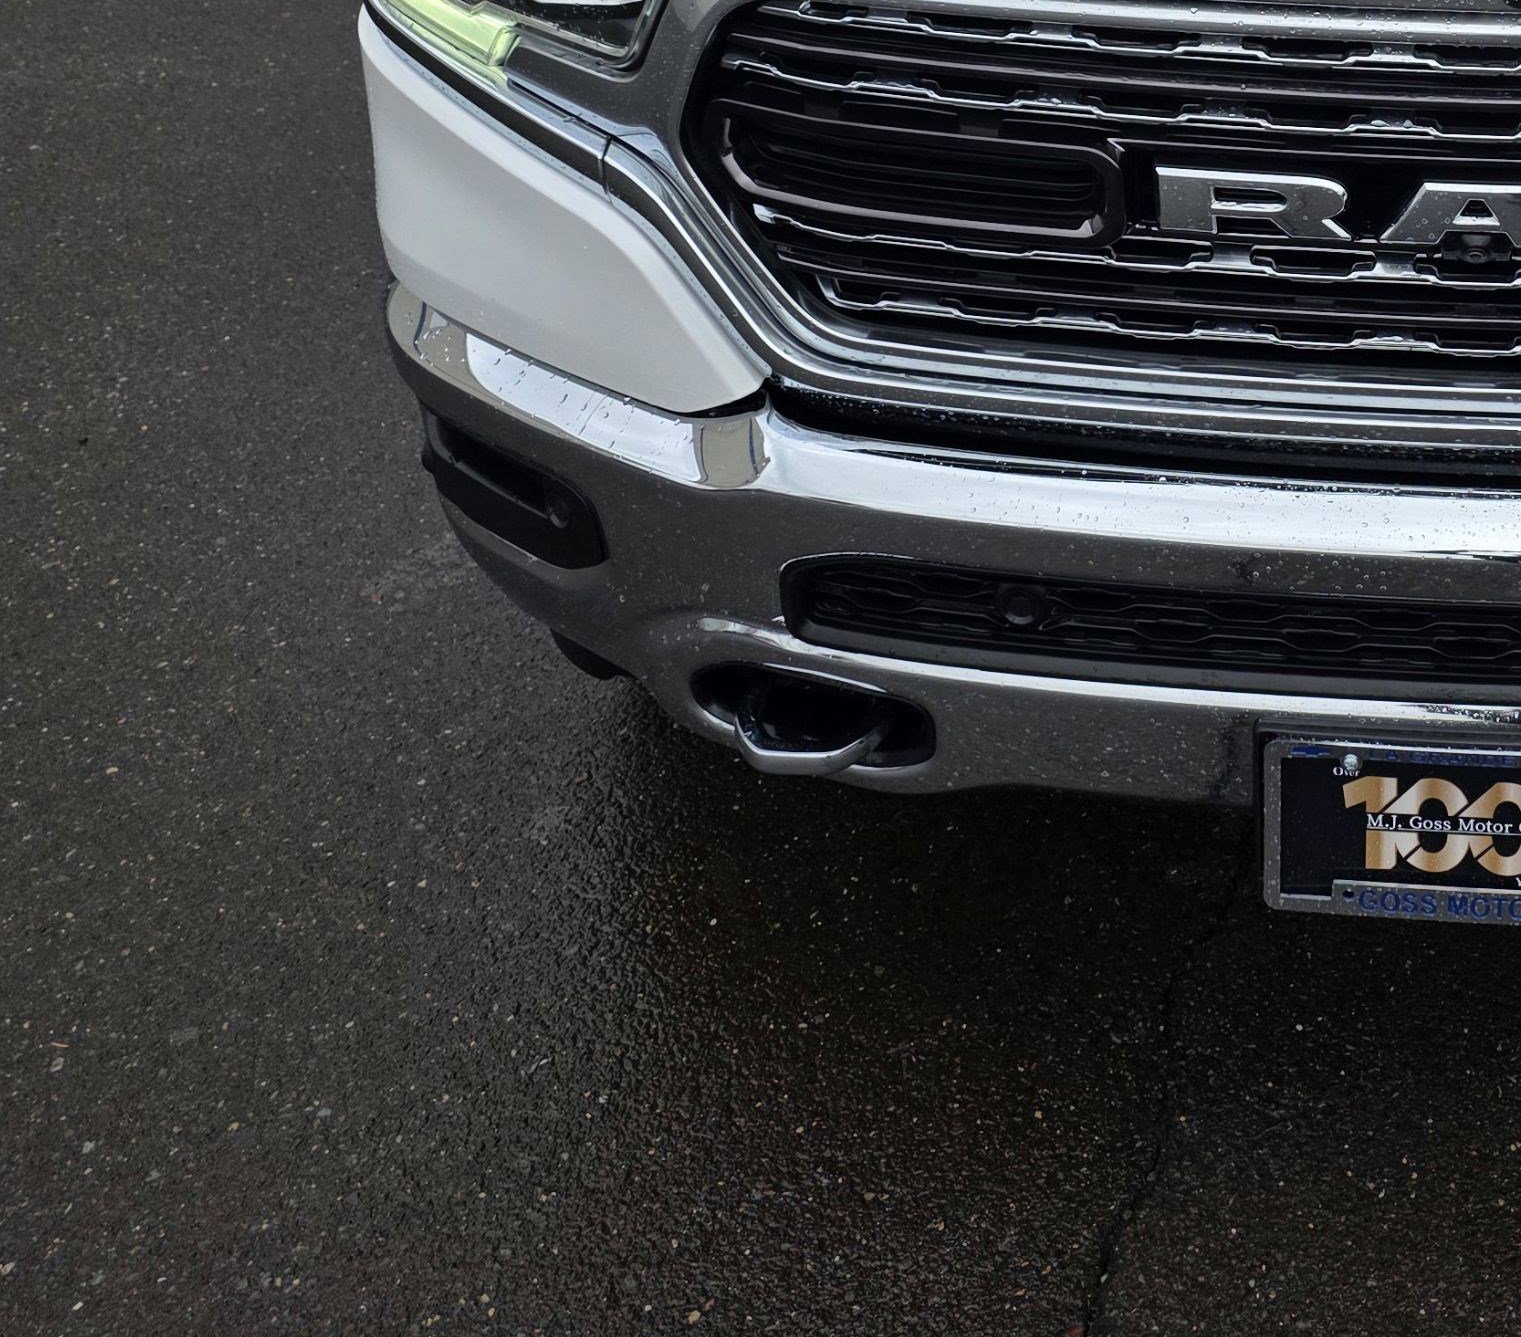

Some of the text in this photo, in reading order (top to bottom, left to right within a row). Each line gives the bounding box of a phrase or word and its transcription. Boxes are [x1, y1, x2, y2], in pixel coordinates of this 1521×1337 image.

[1366, 813, 1402, 830] M.J.
[1409, 815, 1451, 831] Goss
[1458, 818, 1513, 835] Motor
[1358, 889, 1438, 915] GOSS
